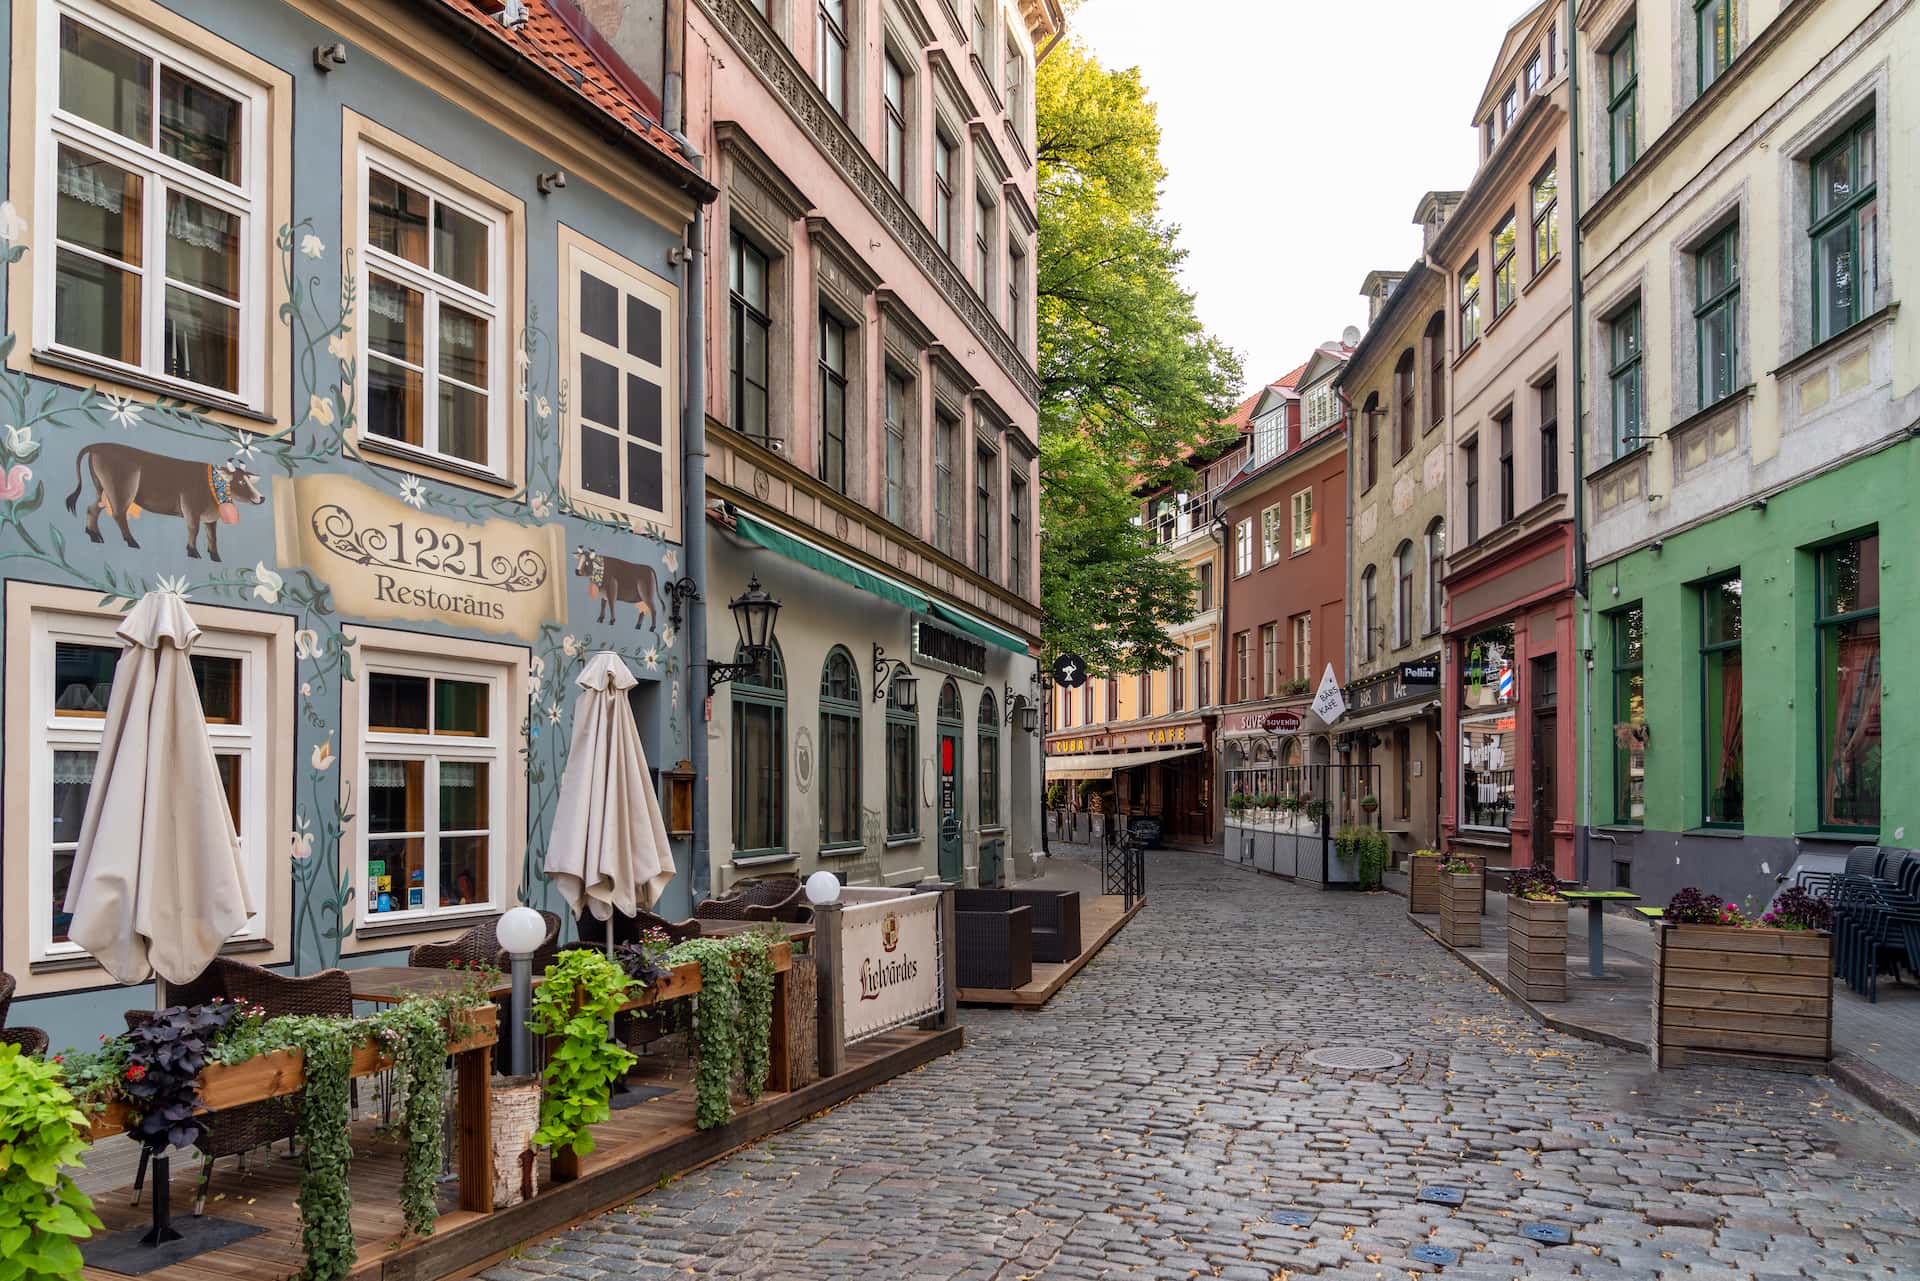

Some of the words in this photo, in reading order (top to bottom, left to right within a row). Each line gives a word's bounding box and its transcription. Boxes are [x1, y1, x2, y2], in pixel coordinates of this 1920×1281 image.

[389, 522, 489, 580] 1221
[374, 573, 505, 620] Restorāns
[1405, 666, 1435, 678] Pellini
[1056, 740, 1084, 753] CUBA
[1150, 727, 1185, 744] CAFE
